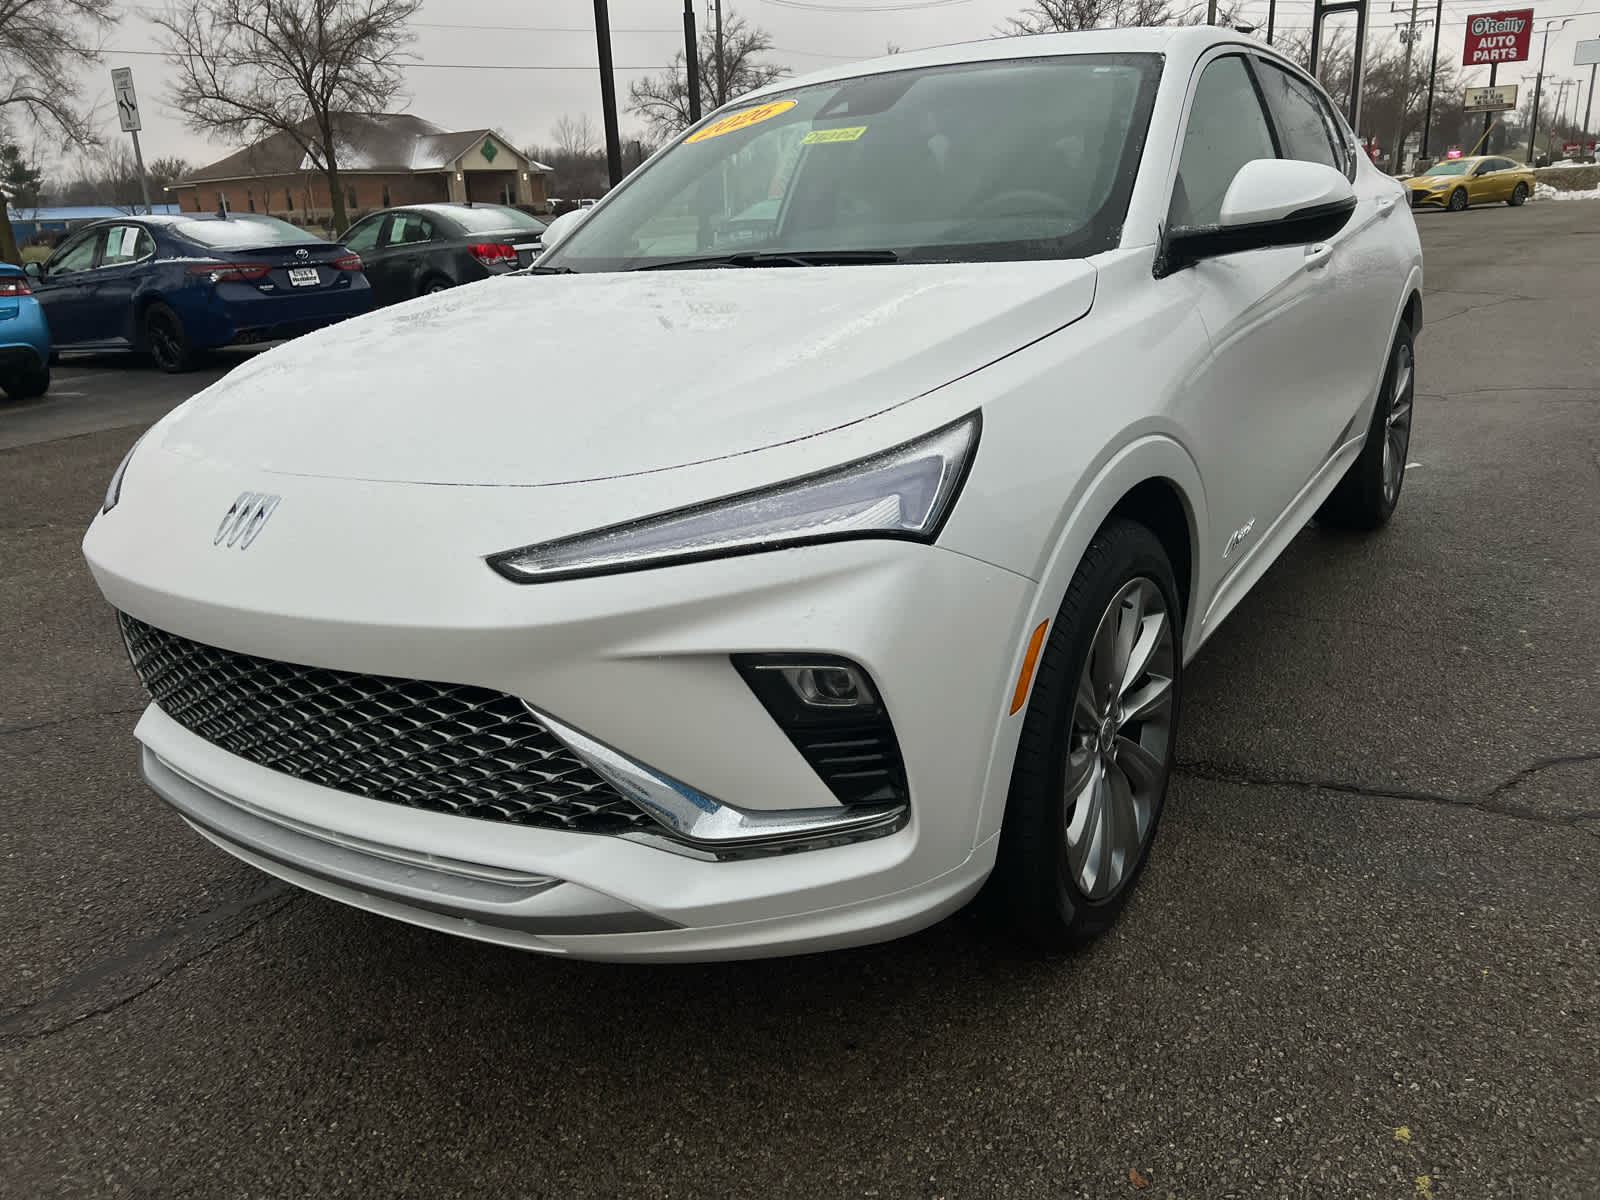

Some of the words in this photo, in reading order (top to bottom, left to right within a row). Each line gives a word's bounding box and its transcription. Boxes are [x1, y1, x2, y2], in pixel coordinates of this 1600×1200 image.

[1472, 17, 1526, 36] O'Reilly
[1478, 35, 1516, 48] AUTO
[1473, 47, 1518, 62] PARTS
[696, 104, 777, 140] 2026
